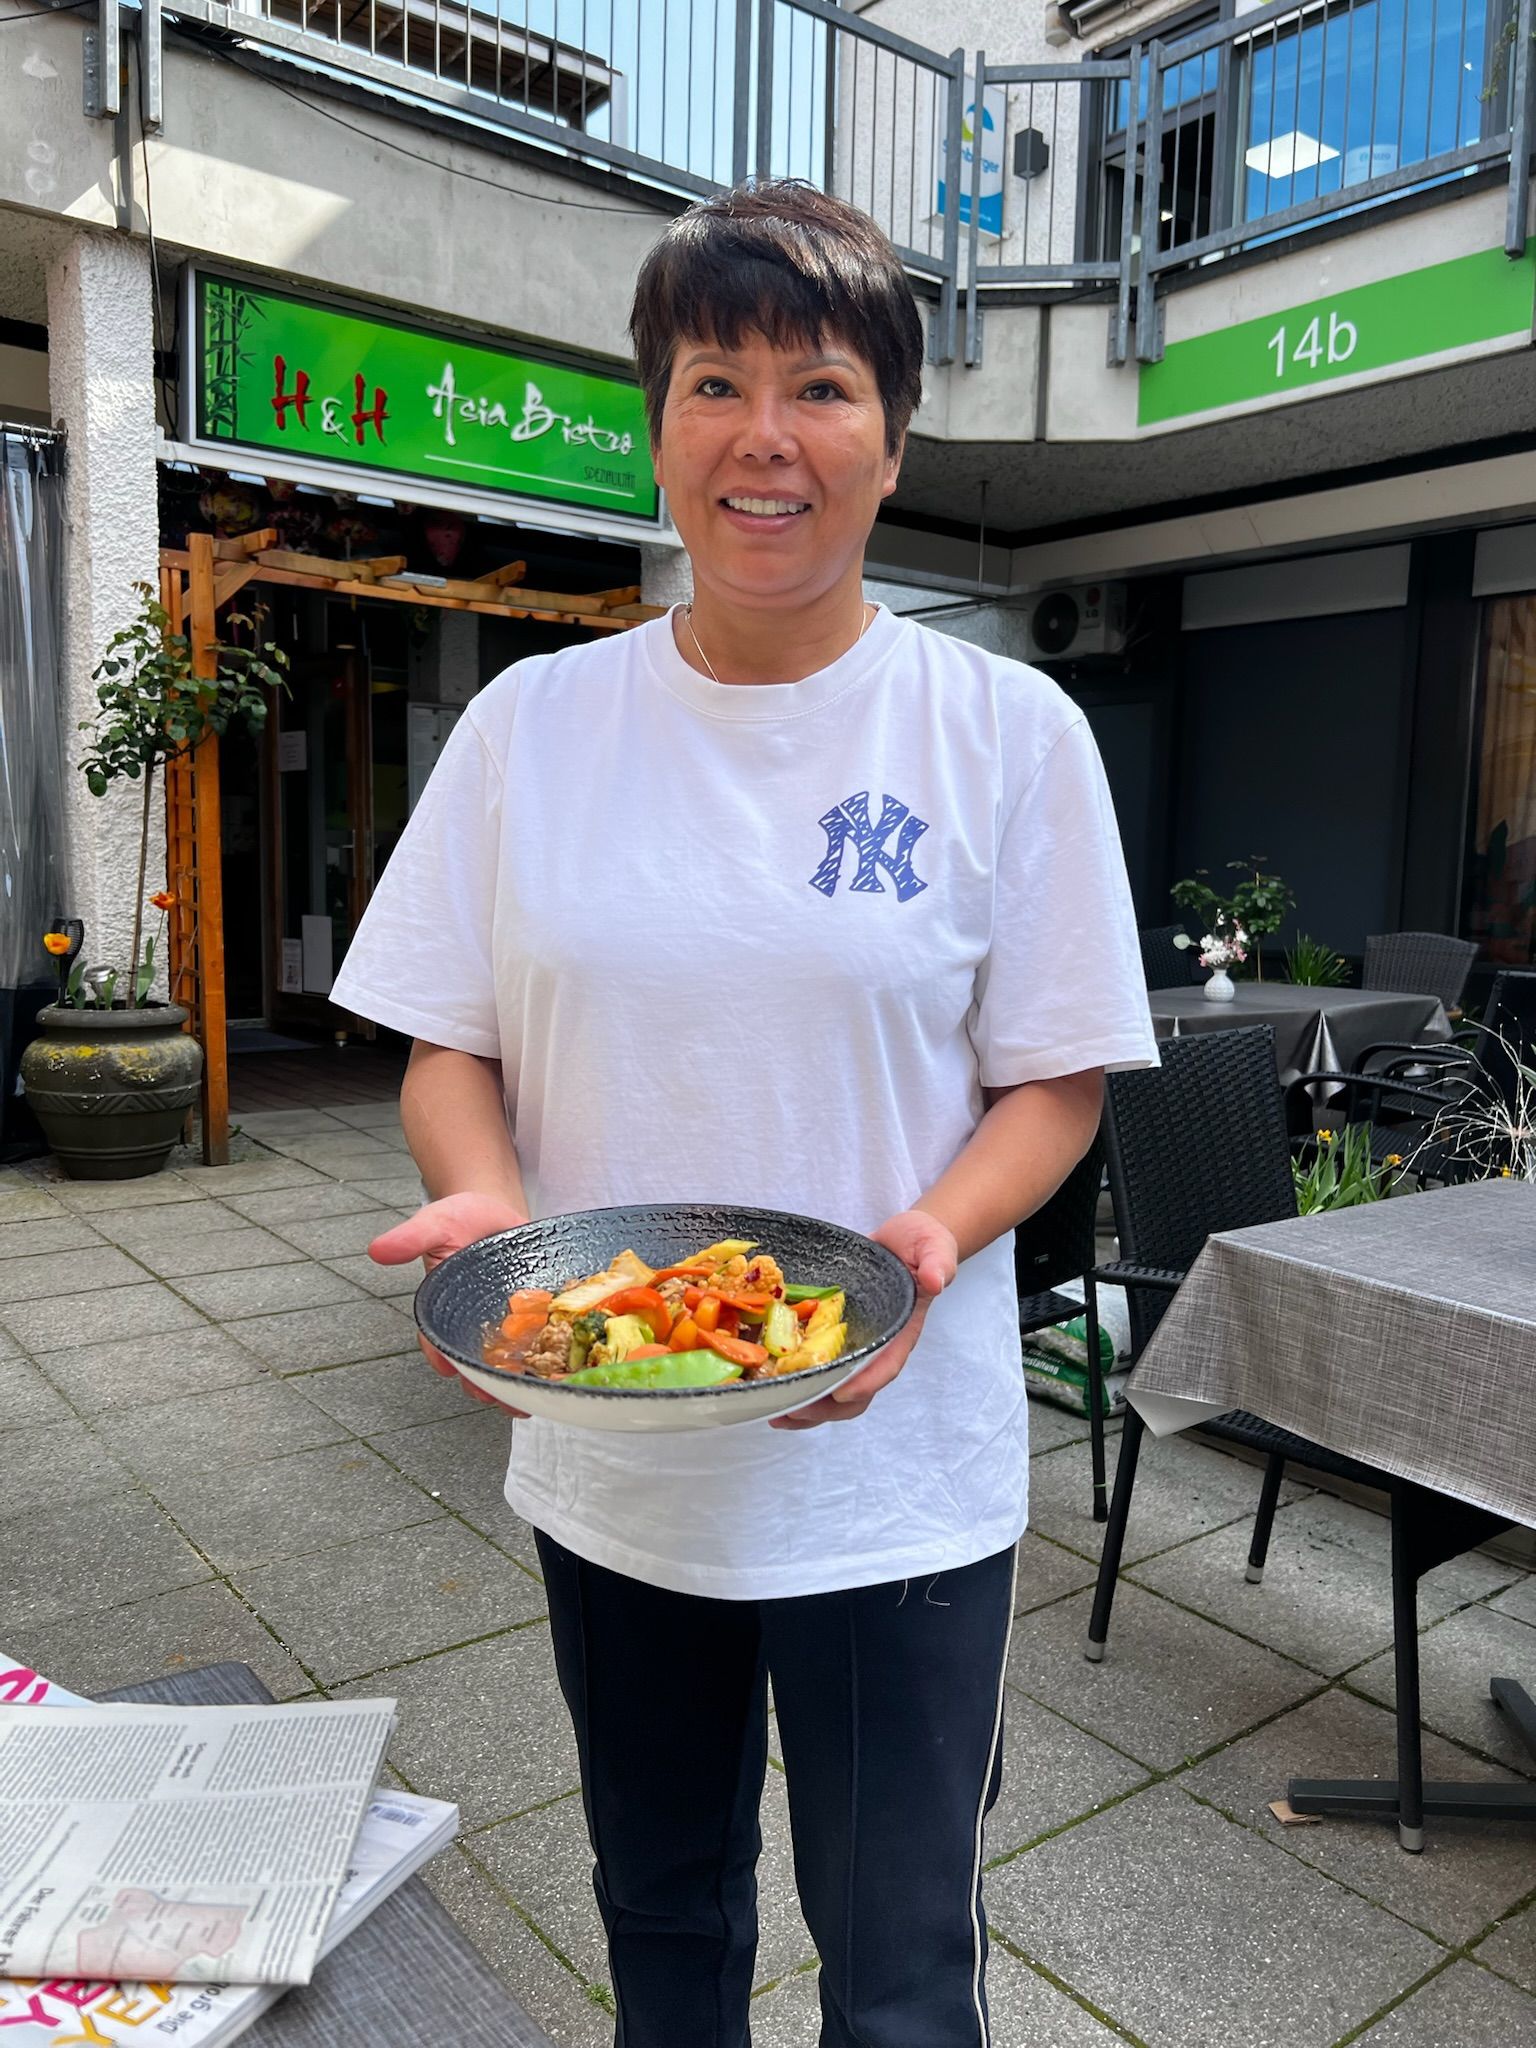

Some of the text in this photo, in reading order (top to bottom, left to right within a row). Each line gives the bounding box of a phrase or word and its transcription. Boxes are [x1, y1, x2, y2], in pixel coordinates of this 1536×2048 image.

[1267, 311, 1358, 378] 14b
[270, 354, 636, 456] H & H Asia Bistro
[807, 790, 930, 903] NY
[155, 2011, 195, 2034] Die
